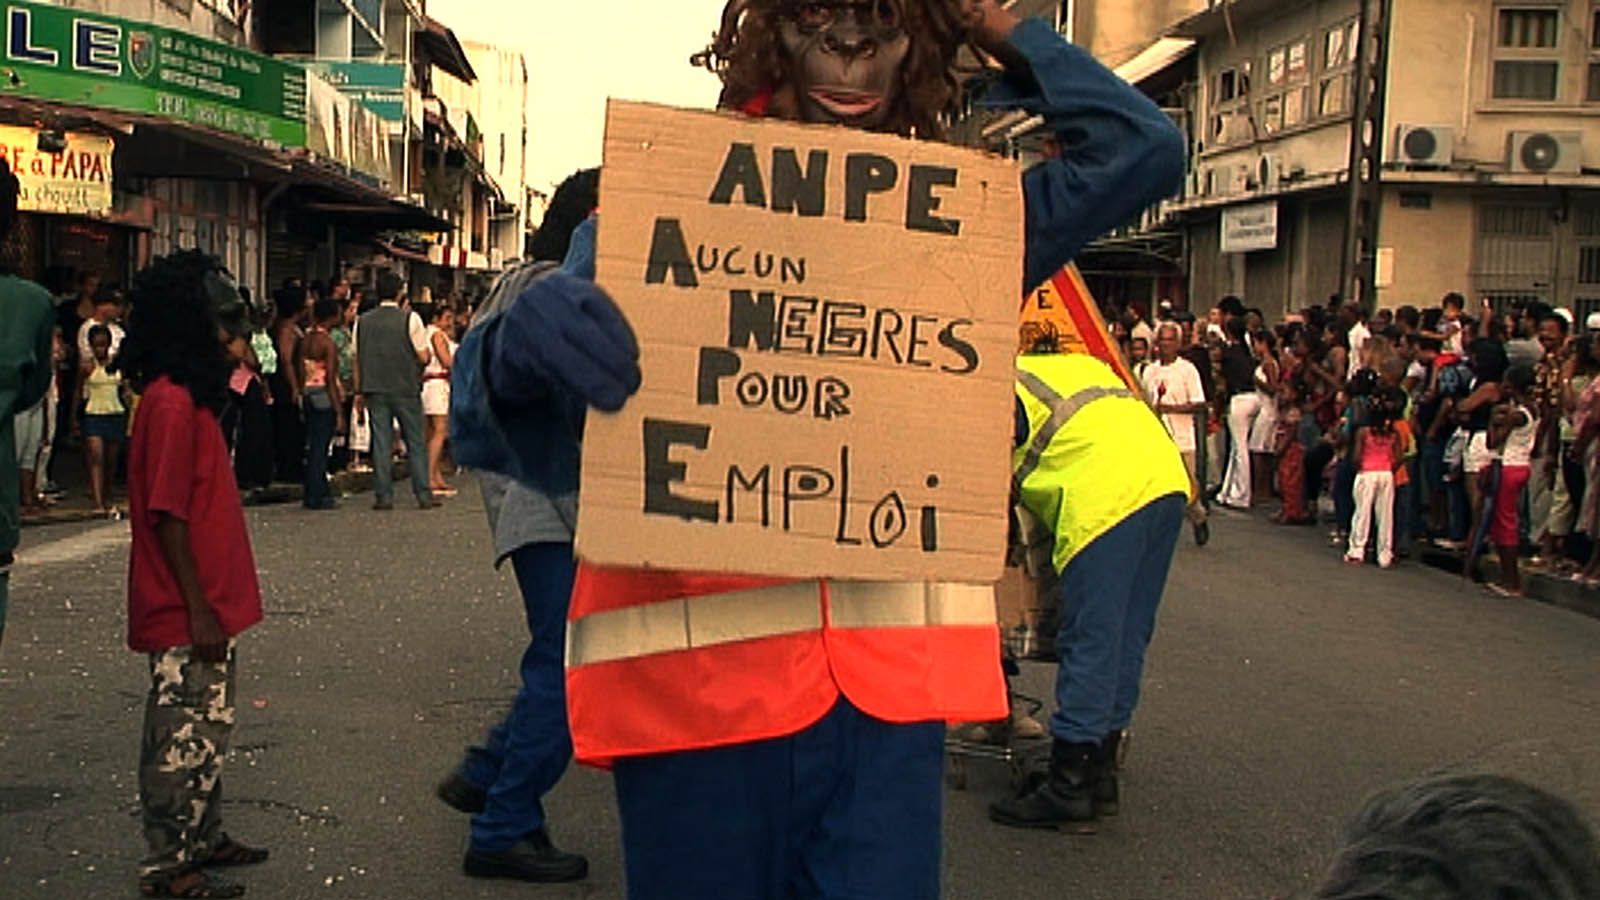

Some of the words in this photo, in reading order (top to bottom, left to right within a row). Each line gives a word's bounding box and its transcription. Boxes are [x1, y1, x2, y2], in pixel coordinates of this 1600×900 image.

[51, 149, 104, 182] PAPA
[708, 142, 961, 236] ANPE
[728, 289, 979, 374] NEGRES
